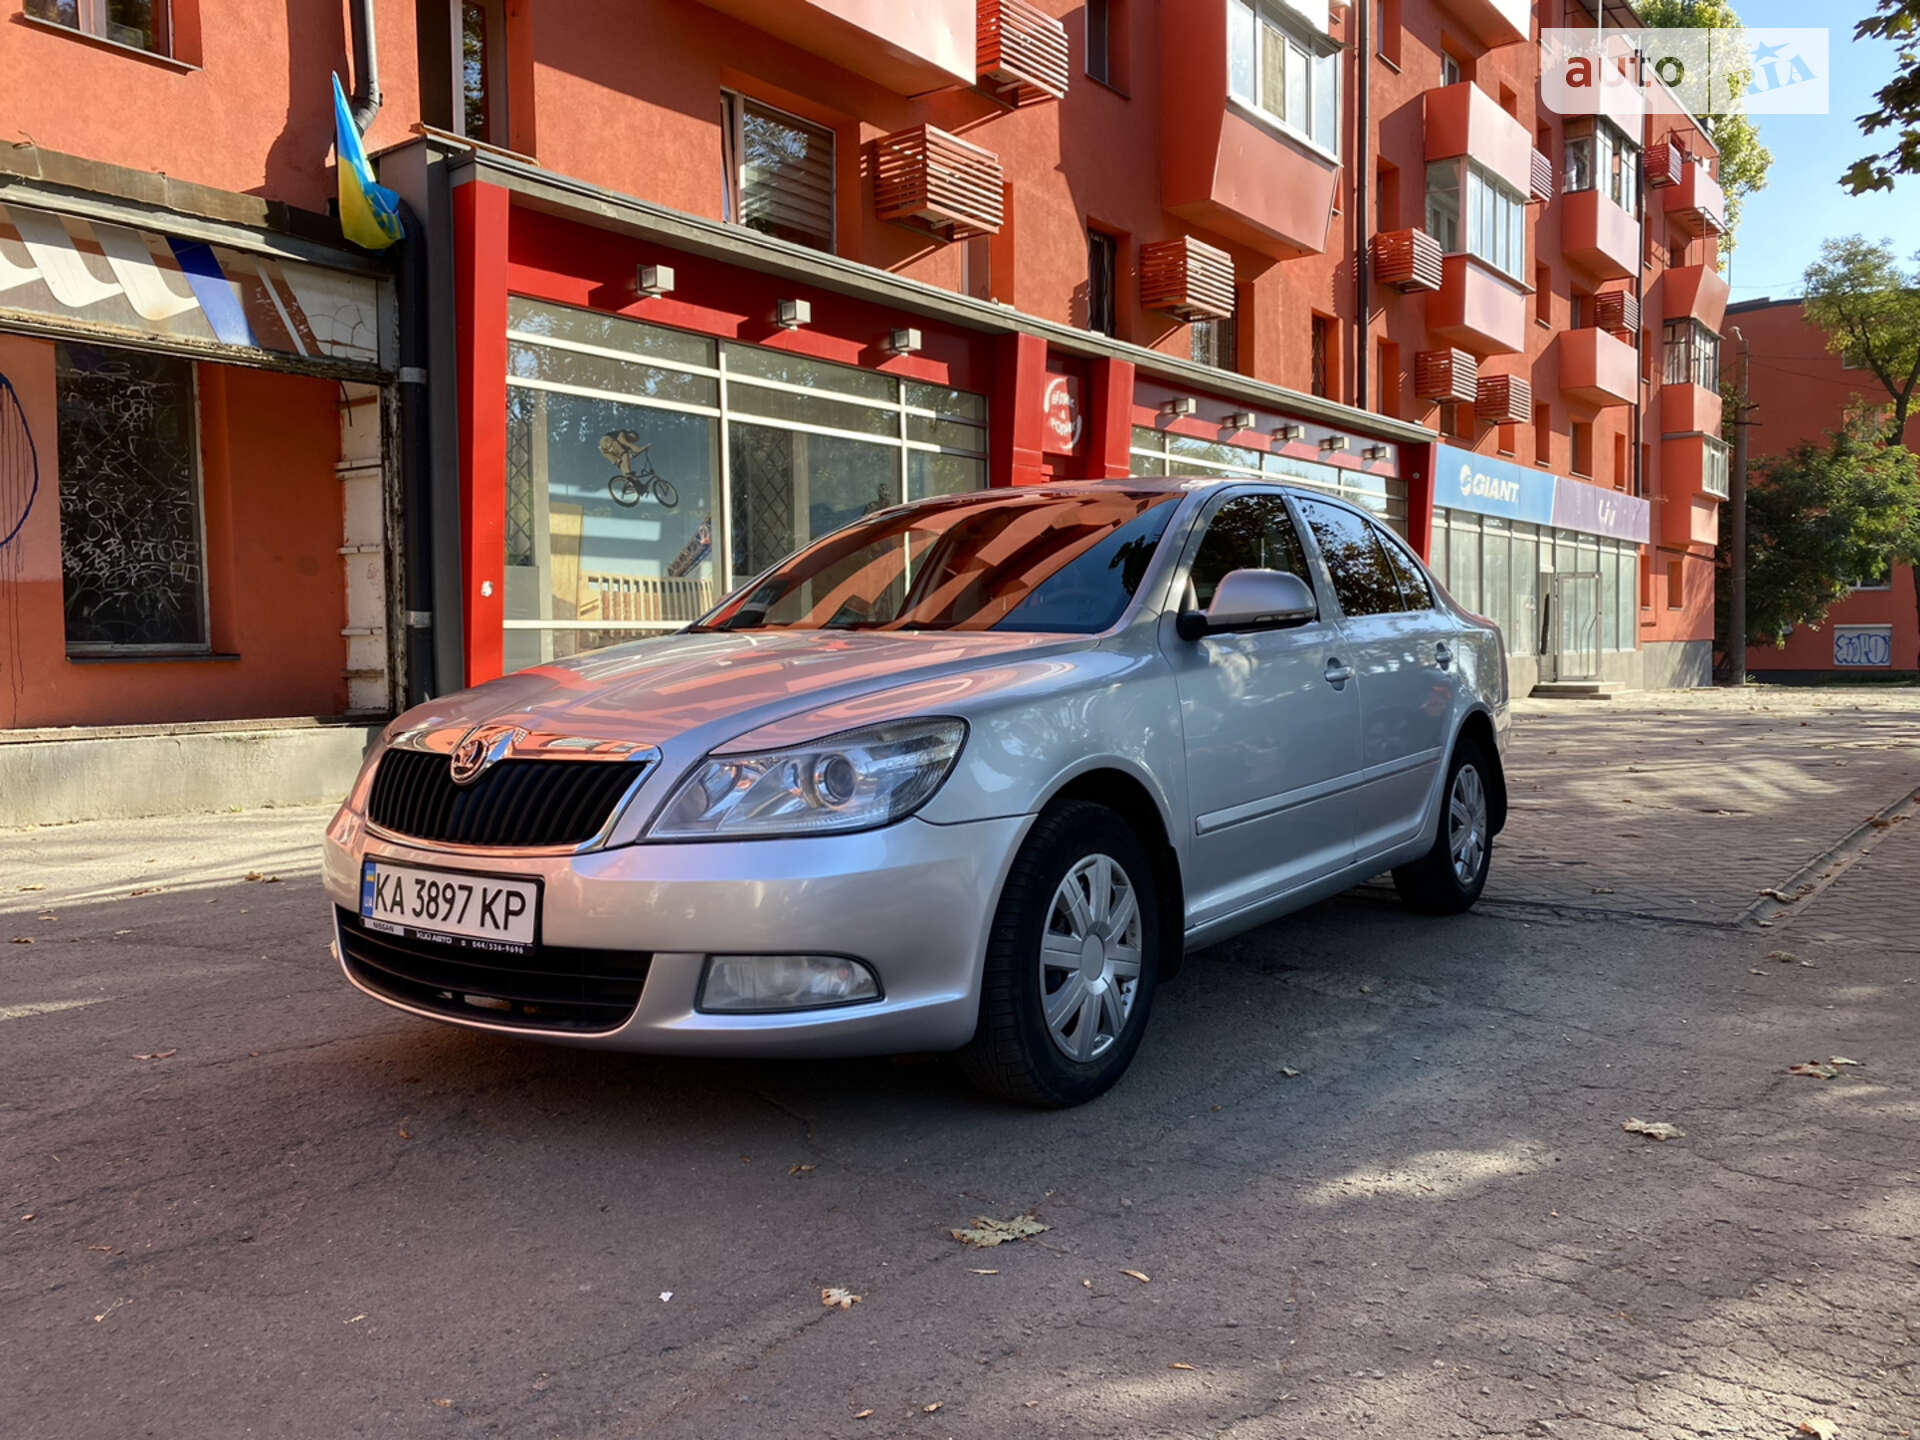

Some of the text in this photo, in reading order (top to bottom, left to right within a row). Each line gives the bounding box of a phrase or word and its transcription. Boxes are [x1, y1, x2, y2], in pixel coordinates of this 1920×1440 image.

[1472, 472, 1520, 503] GIANT
[375, 872, 527, 931] KA 3897 KP
